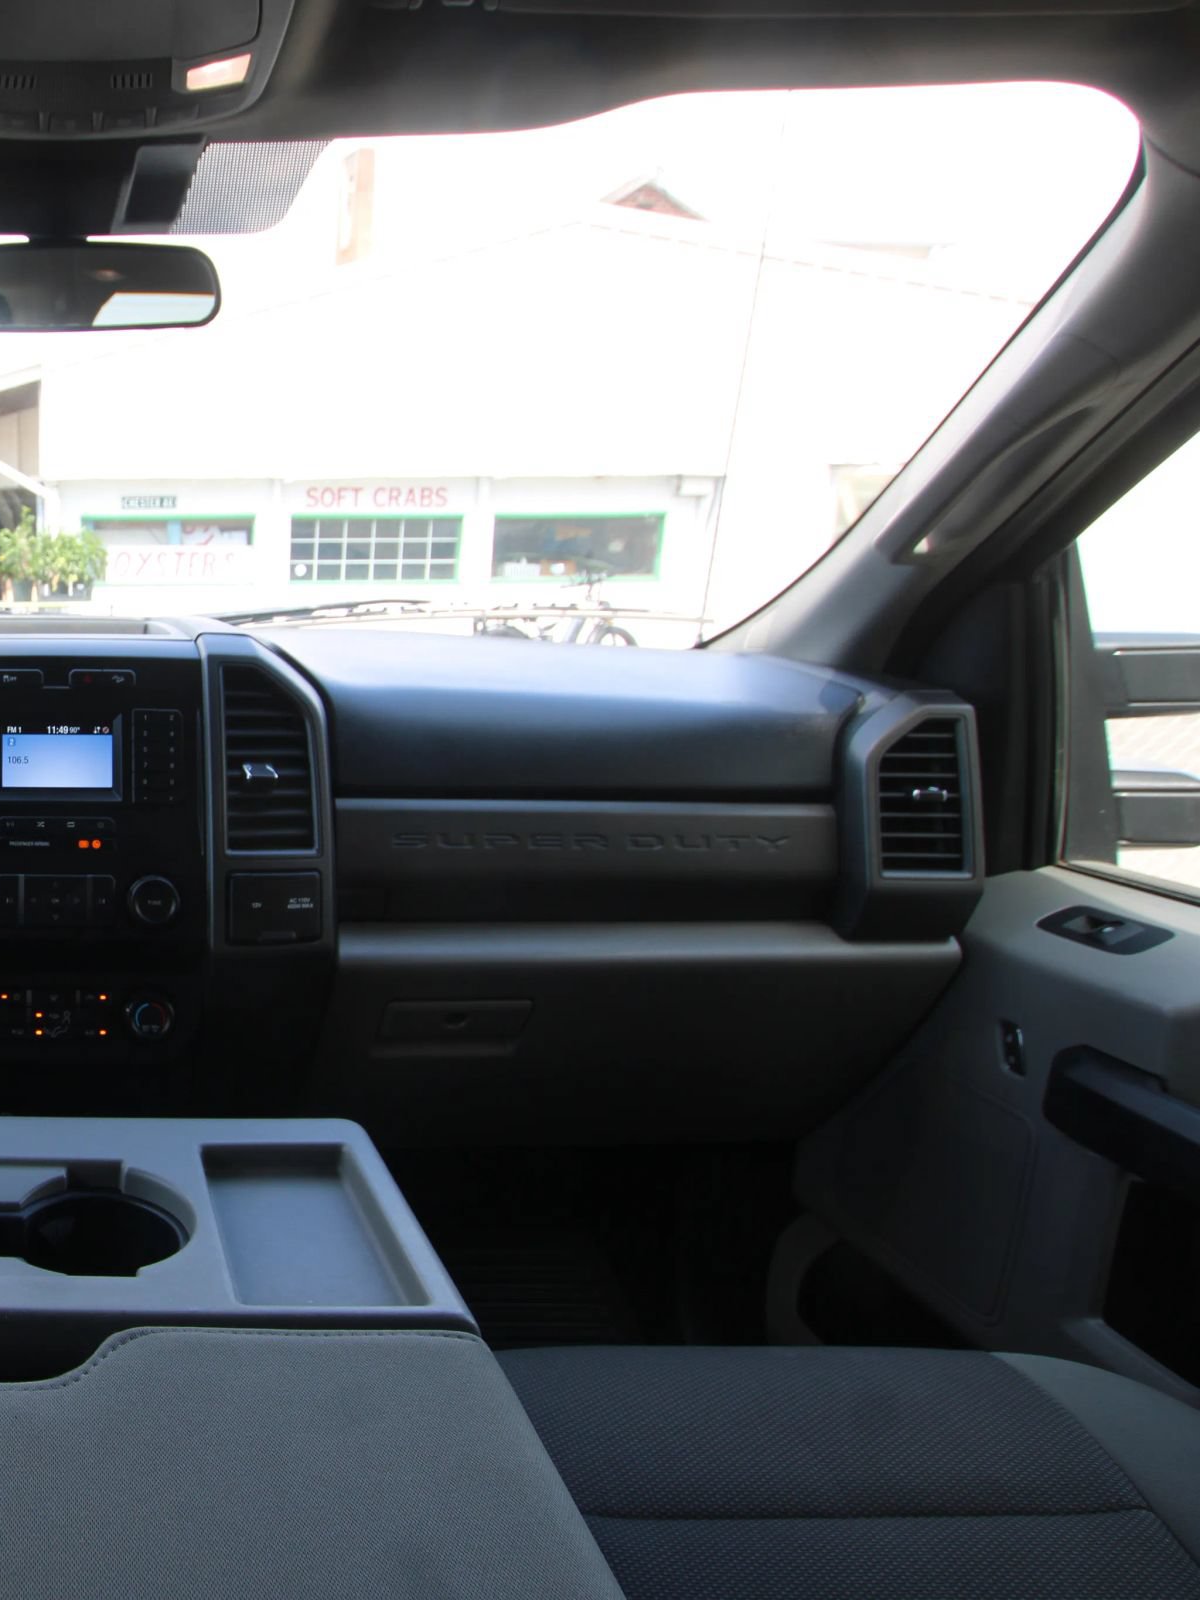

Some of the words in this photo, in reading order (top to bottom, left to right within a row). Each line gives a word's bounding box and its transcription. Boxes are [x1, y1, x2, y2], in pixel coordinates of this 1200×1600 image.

[305, 486, 364, 509] SOFT
[372, 486, 449, 508] CRABS
[7, 726, 17, 734] FM
[18, 726, 22, 734] 1
[46, 725, 69, 735] 11:49
[7, 755, 29, 765] 106.5
[390, 831, 609, 850] SUPER
[624, 831, 792, 852] DUTY
